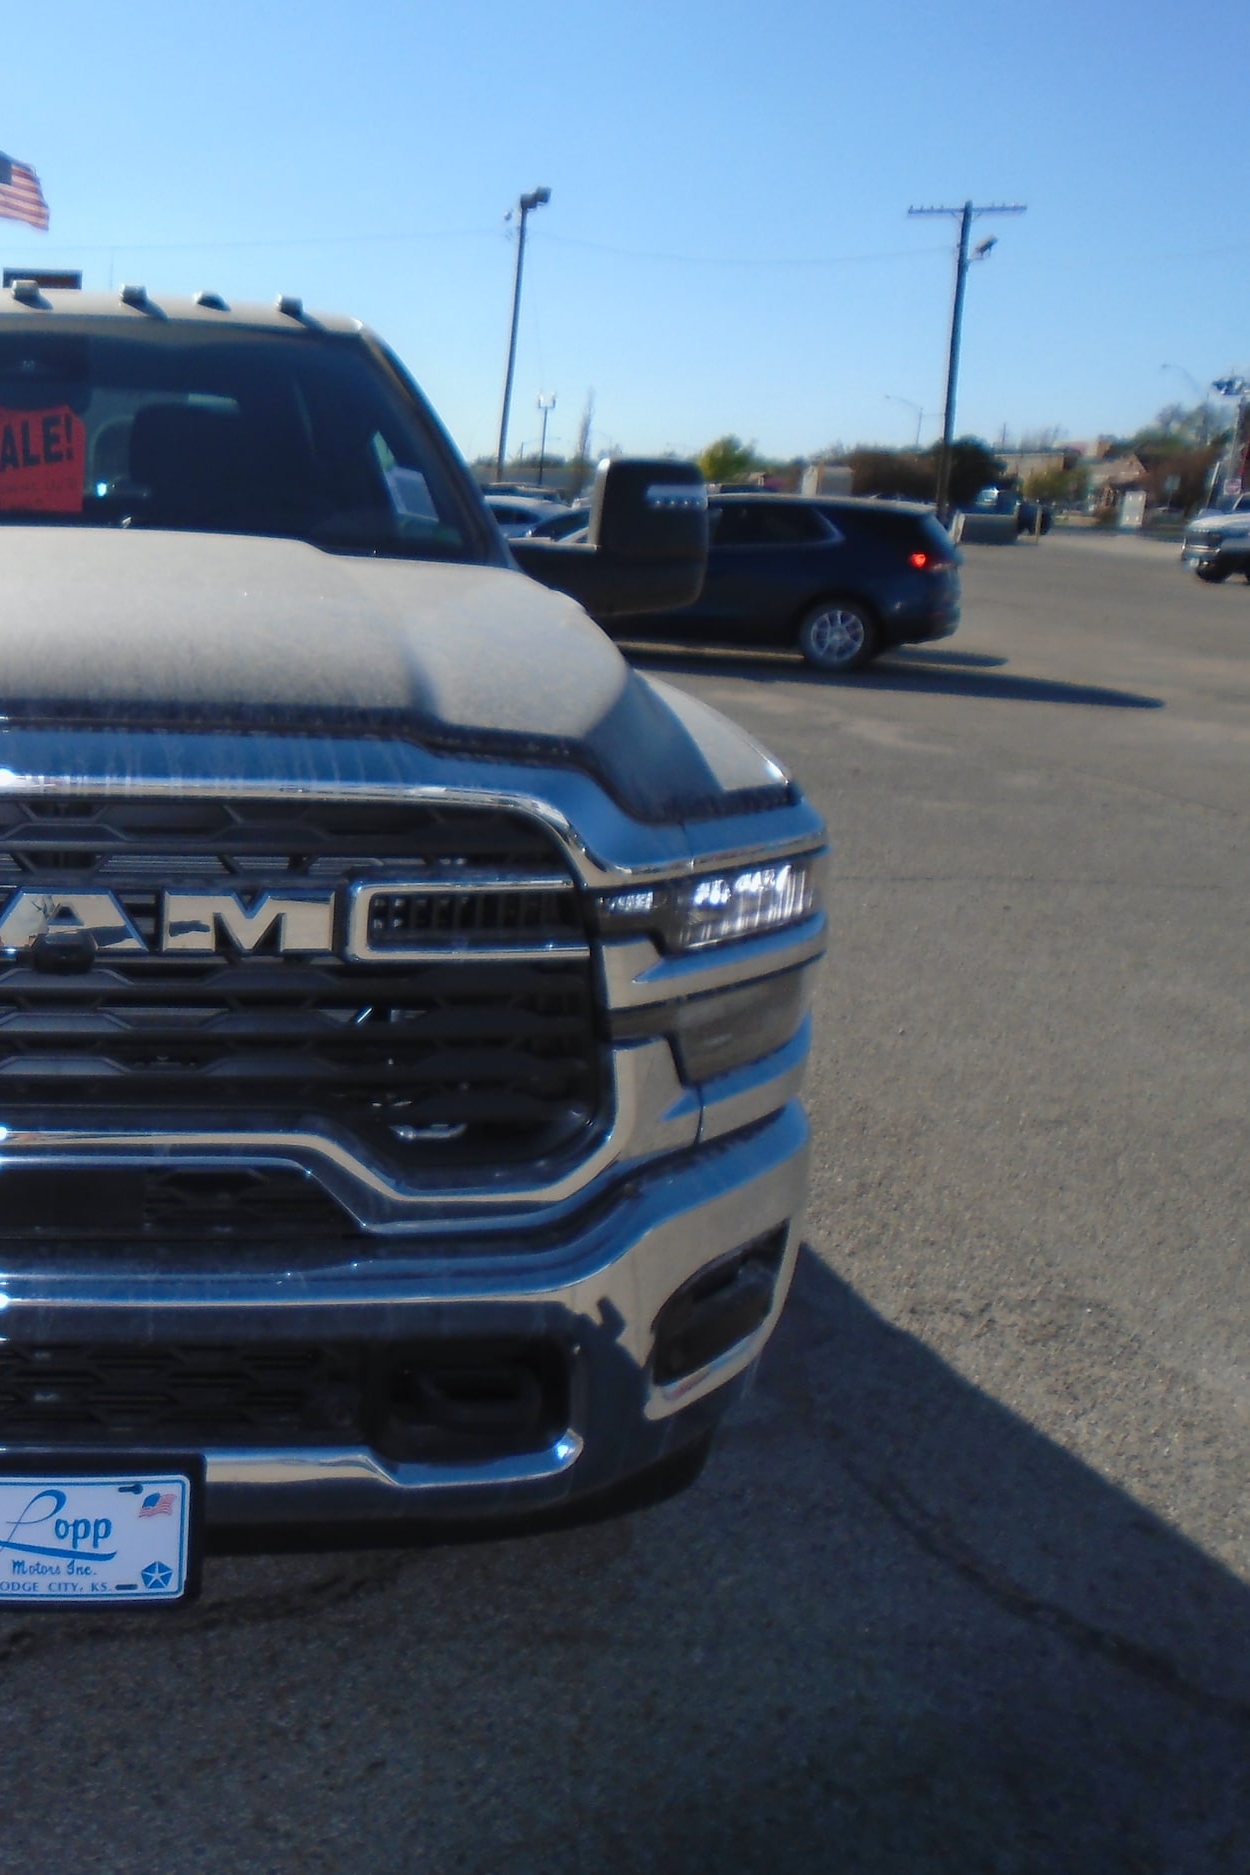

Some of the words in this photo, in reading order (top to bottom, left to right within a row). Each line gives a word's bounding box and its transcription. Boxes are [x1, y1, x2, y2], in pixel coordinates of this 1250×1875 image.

[11, 1559, 61, 1576] Motors
[66, 1558, 98, 1576] Inc.
[48, 1582, 84, 1593] CITY,
